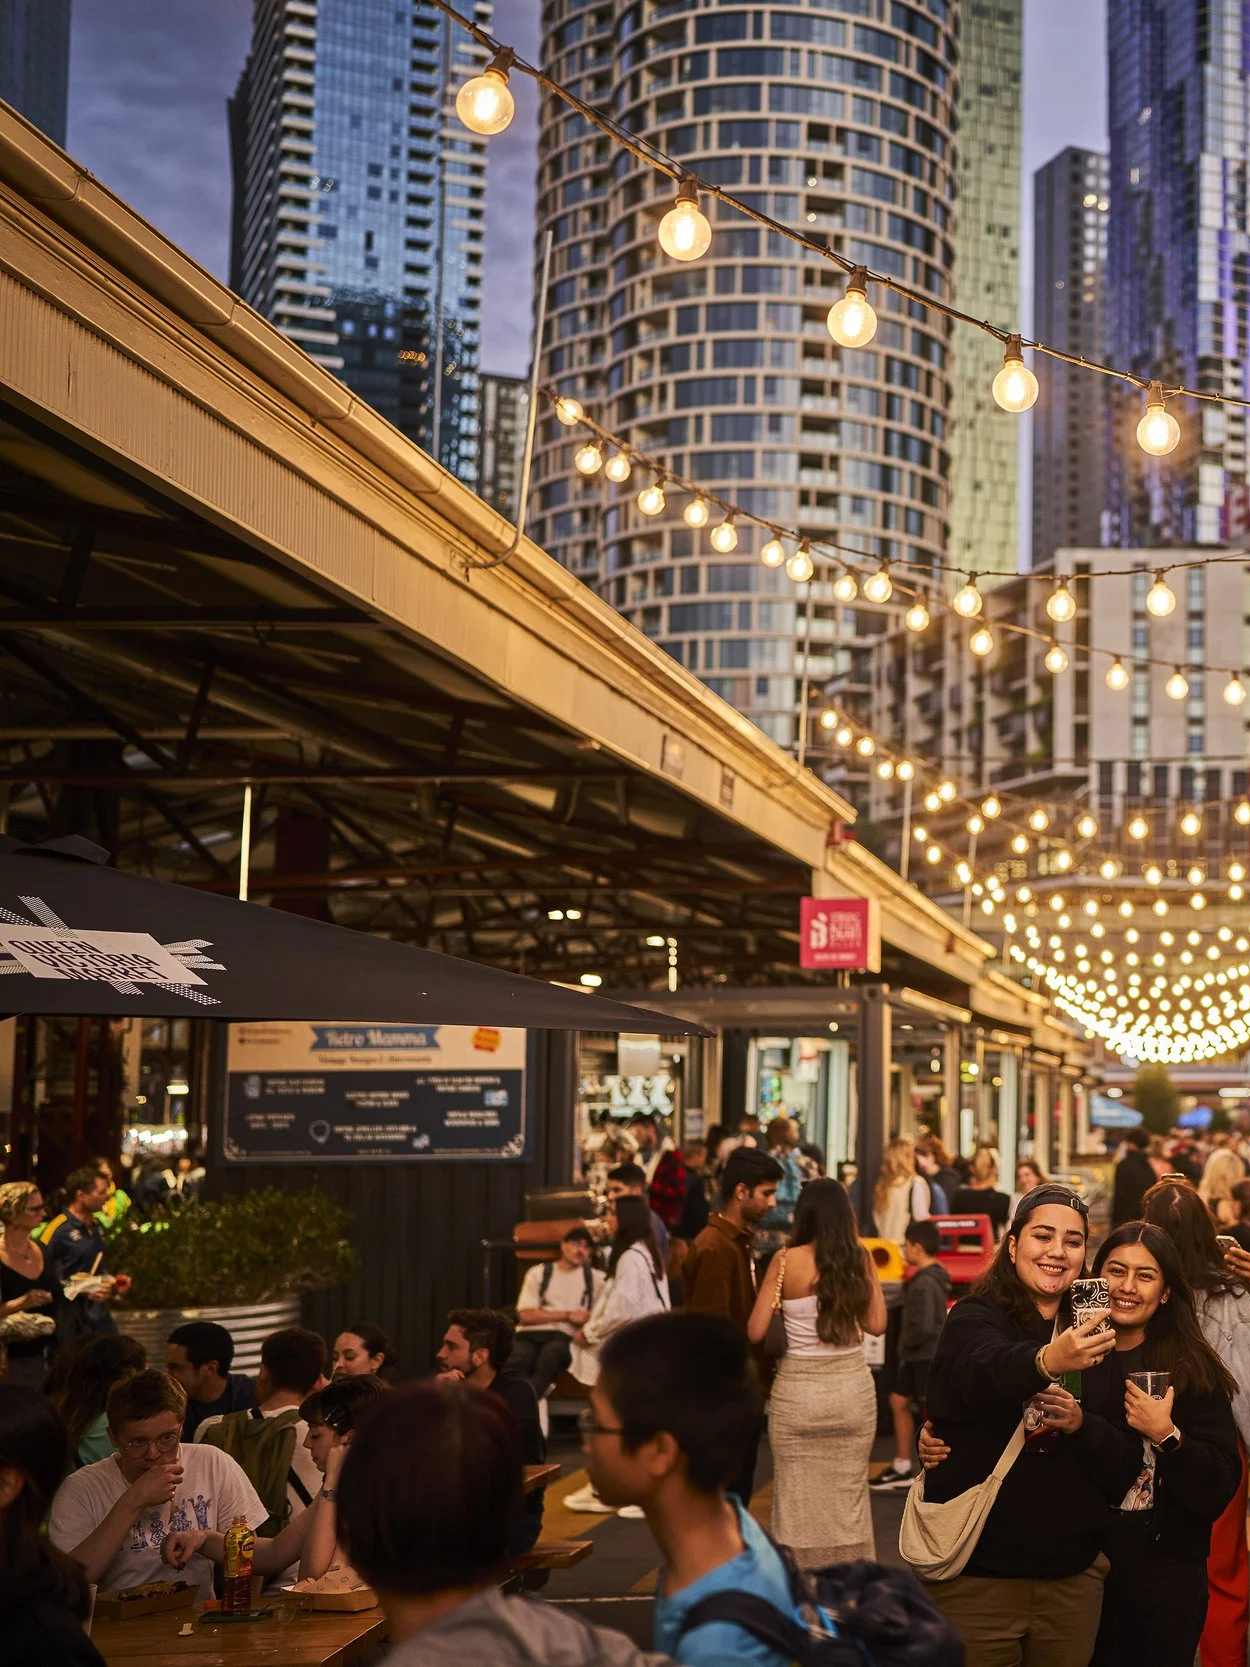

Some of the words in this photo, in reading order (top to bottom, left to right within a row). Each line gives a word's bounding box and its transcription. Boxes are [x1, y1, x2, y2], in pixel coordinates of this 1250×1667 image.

[8, 940, 105, 955] QUEEN
[30, 953, 161, 969] VICTORIA
[54, 965, 169, 981] MARKET
